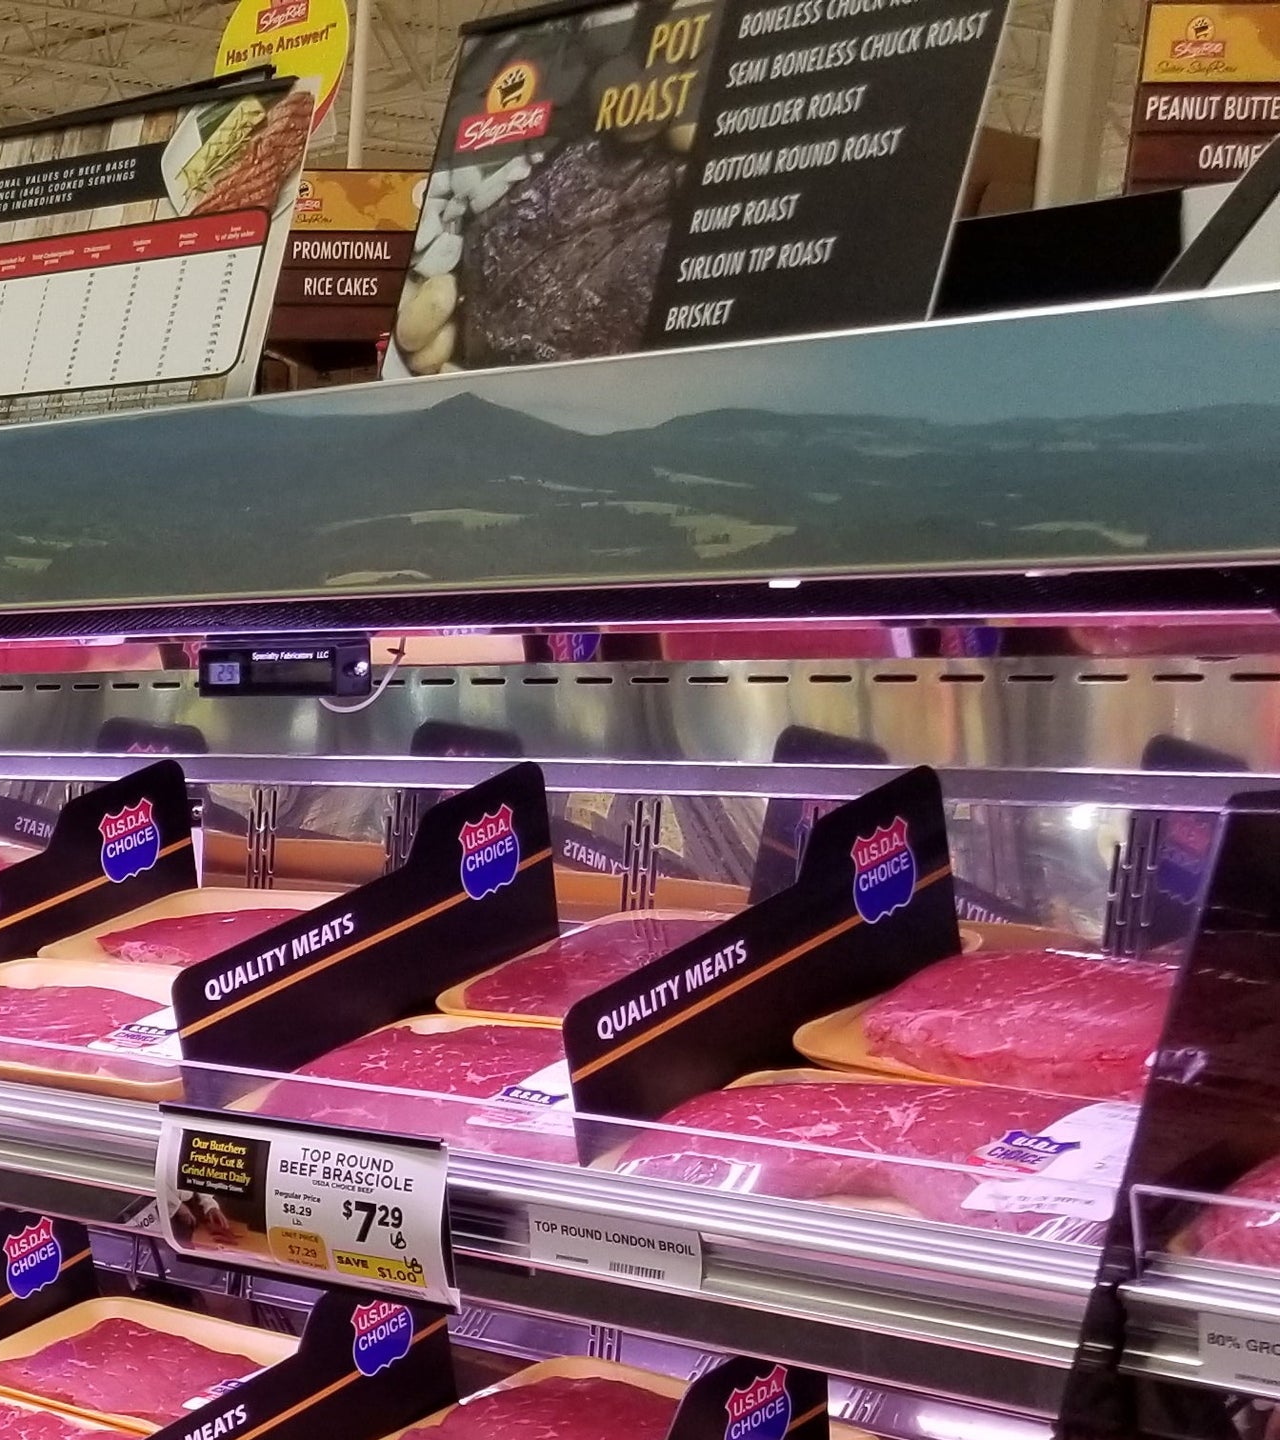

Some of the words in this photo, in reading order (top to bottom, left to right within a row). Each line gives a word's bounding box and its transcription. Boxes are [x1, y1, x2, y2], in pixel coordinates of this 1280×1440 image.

[739, 2, 822, 39] BONELESS
[226, 48, 248, 67] Has
[250, 41, 274, 57] The
[646, 13, 711, 69] POT
[726, 55, 769, 88] SEMI
[770, 37, 857, 80] BONELESS
[860, 24, 921, 62] CHUCK
[925, 9, 993, 49] ROAST
[595, 70, 698, 132] ROAST
[714, 99, 805, 137] SHOULDER
[806, 84, 868, 120] ROAST
[1146, 96, 1222, 120] PEANUT
[460, 107, 544, 150] ShopRite
[25, 172, 59, 186] VALUES
[63, 169, 75, 179] OF
[78, 164, 102, 176] BEEF
[105, 158, 136, 172] BASED
[702, 153, 771, 186] BOTTOM
[774, 138, 839, 174] ROUND
[841, 125, 905, 163] ROAST
[48, 179, 84, 193] COOKED
[88, 170, 135, 186] SERVINGS
[12, 192, 72, 210] INGREDIENTS
[690, 201, 741, 234] RUMP
[742, 193, 801, 227] ROAST
[292, 241, 391, 260] PROMOTIONAL
[678, 249, 747, 283] SIRLOIN
[748, 246, 776, 273] TIP
[777, 236, 837, 268] ROAST
[304, 277, 334, 296] RICE
[336, 277, 378, 296] CAKES
[665, 298, 735, 331] BRISKET
[317, 651, 329, 659] LLC
[105, 827, 155, 858] CHOICE
[858, 853, 910, 892] CHOICE
[204, 945, 287, 1003] QUALITY
[290, 912, 356, 964] MEATS
[597, 974, 683, 1041] QUALITY
[684, 938, 748, 1000] MEATS
[279, 1159, 318, 1179] BEEF
[322, 1166, 413, 1193] BRASCIOLE
[300, 1147, 331, 1165] TOP
[336, 1153, 394, 1174] ROUND
[534, 1220, 557, 1235] TOP
[560, 1223, 602, 1240] ROUND
[605, 1228, 656, 1248] LONDON
[659, 1237, 696, 1257] BROIL
